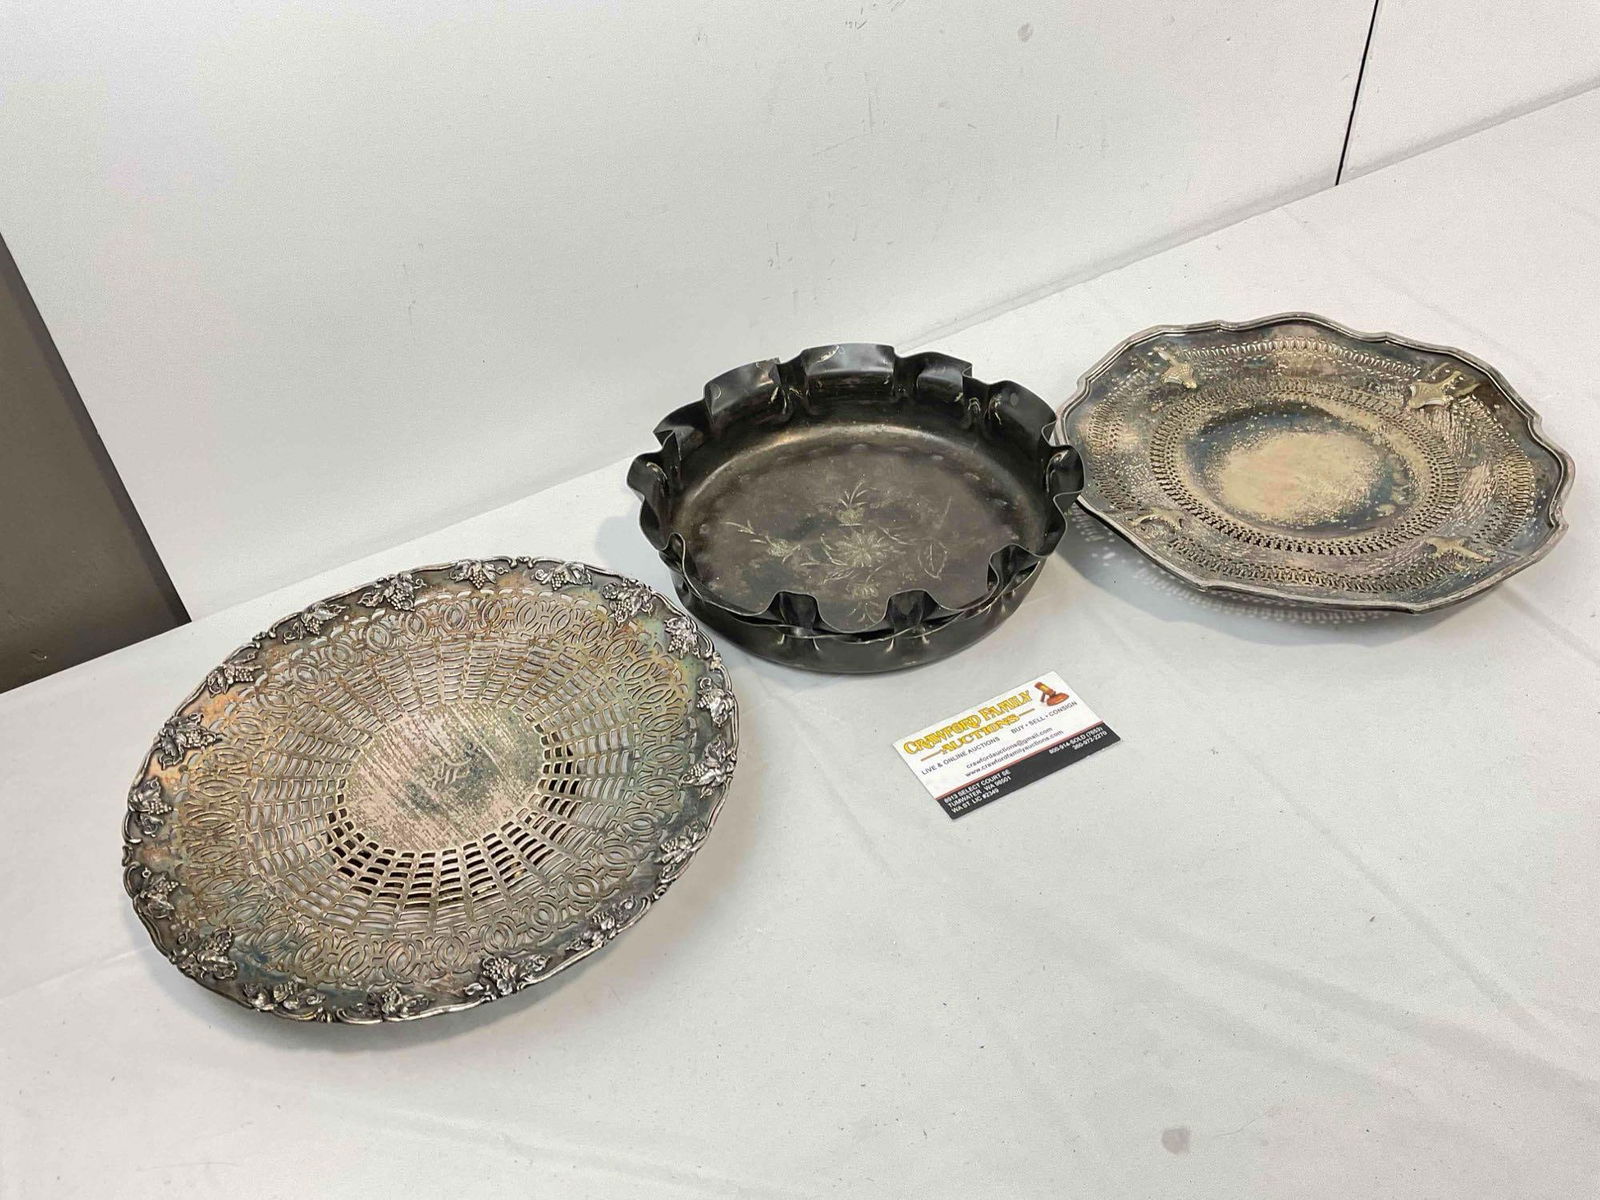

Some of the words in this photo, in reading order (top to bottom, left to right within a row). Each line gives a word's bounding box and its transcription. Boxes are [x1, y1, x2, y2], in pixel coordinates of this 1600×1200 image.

[903, 714, 982, 755] CRAWFORD
[978, 690, 1032, 721] FAMILY
[941, 714, 1020, 756] AUCTIONS
[1011, 725, 1025, 734] BUY
[1028, 715, 1046, 726] SELL
[1048, 701, 1078, 717] CONSIGN
[921, 765, 937, 775] LIVE
[943, 750, 967, 765] ONLINE
[968, 736, 1001, 755] AUCTIONS
[965, 730, 1065, 777] www.crawfordfamilyauctions.com
[966, 727, 1053, 769] crawfordauctions@gmail.com
[957, 782, 981, 797] SELECT
[980, 774, 1001, 787] COURT
[983, 783, 996, 792] WA
